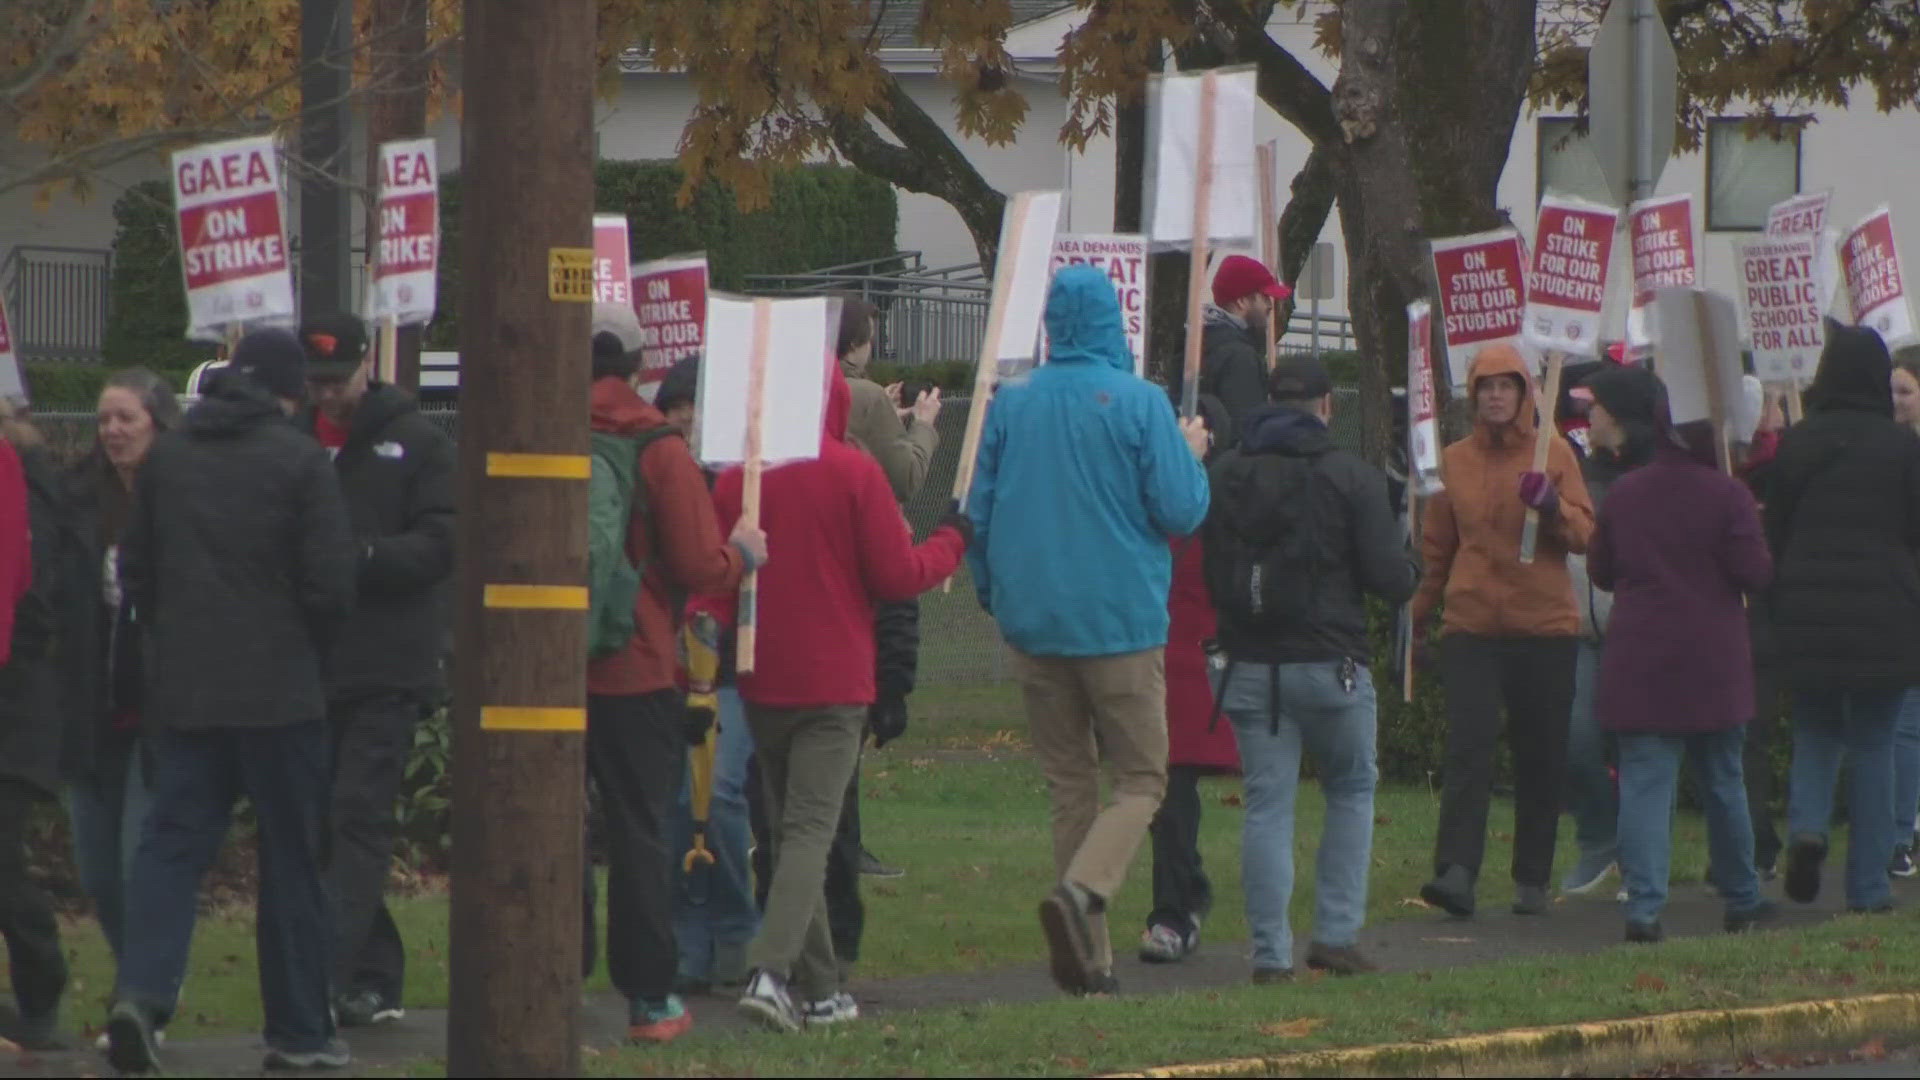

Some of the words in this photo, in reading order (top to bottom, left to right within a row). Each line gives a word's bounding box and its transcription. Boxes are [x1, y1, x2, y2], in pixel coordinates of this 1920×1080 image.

[179, 151, 271, 196] GAEA
[206, 207, 247, 240] ON
[1563, 215, 1585, 237] ON
[1641, 211, 1660, 232] ON
[186, 235, 284, 276] STRIKE
[380, 235, 433, 266] RIKE
[1083, 241, 1142, 255] DEMANDS
[1547, 233, 1599, 261] STRIKE
[1463, 250, 1487, 271] ON
[1539, 253, 1567, 275] FOR
[1569, 259, 1600, 282] OUR
[1653, 249, 1687, 271] OUR
[1745, 256, 1812, 284] GREAT
[648, 278, 670, 300] ON
[1452, 268, 1508, 292] STRIKE
[1531, 271, 1603, 303] STUDENTS
[1450, 292, 1480, 312] FOR
[1482, 288, 1517, 309] OUR
[1748, 282, 1816, 308] PUBLIC
[1752, 307, 1819, 328] SCHOOLS
[661, 321, 699, 345] OUR
[1753, 331, 1782, 350] FOR
[1787, 327, 1822, 348] ALL
